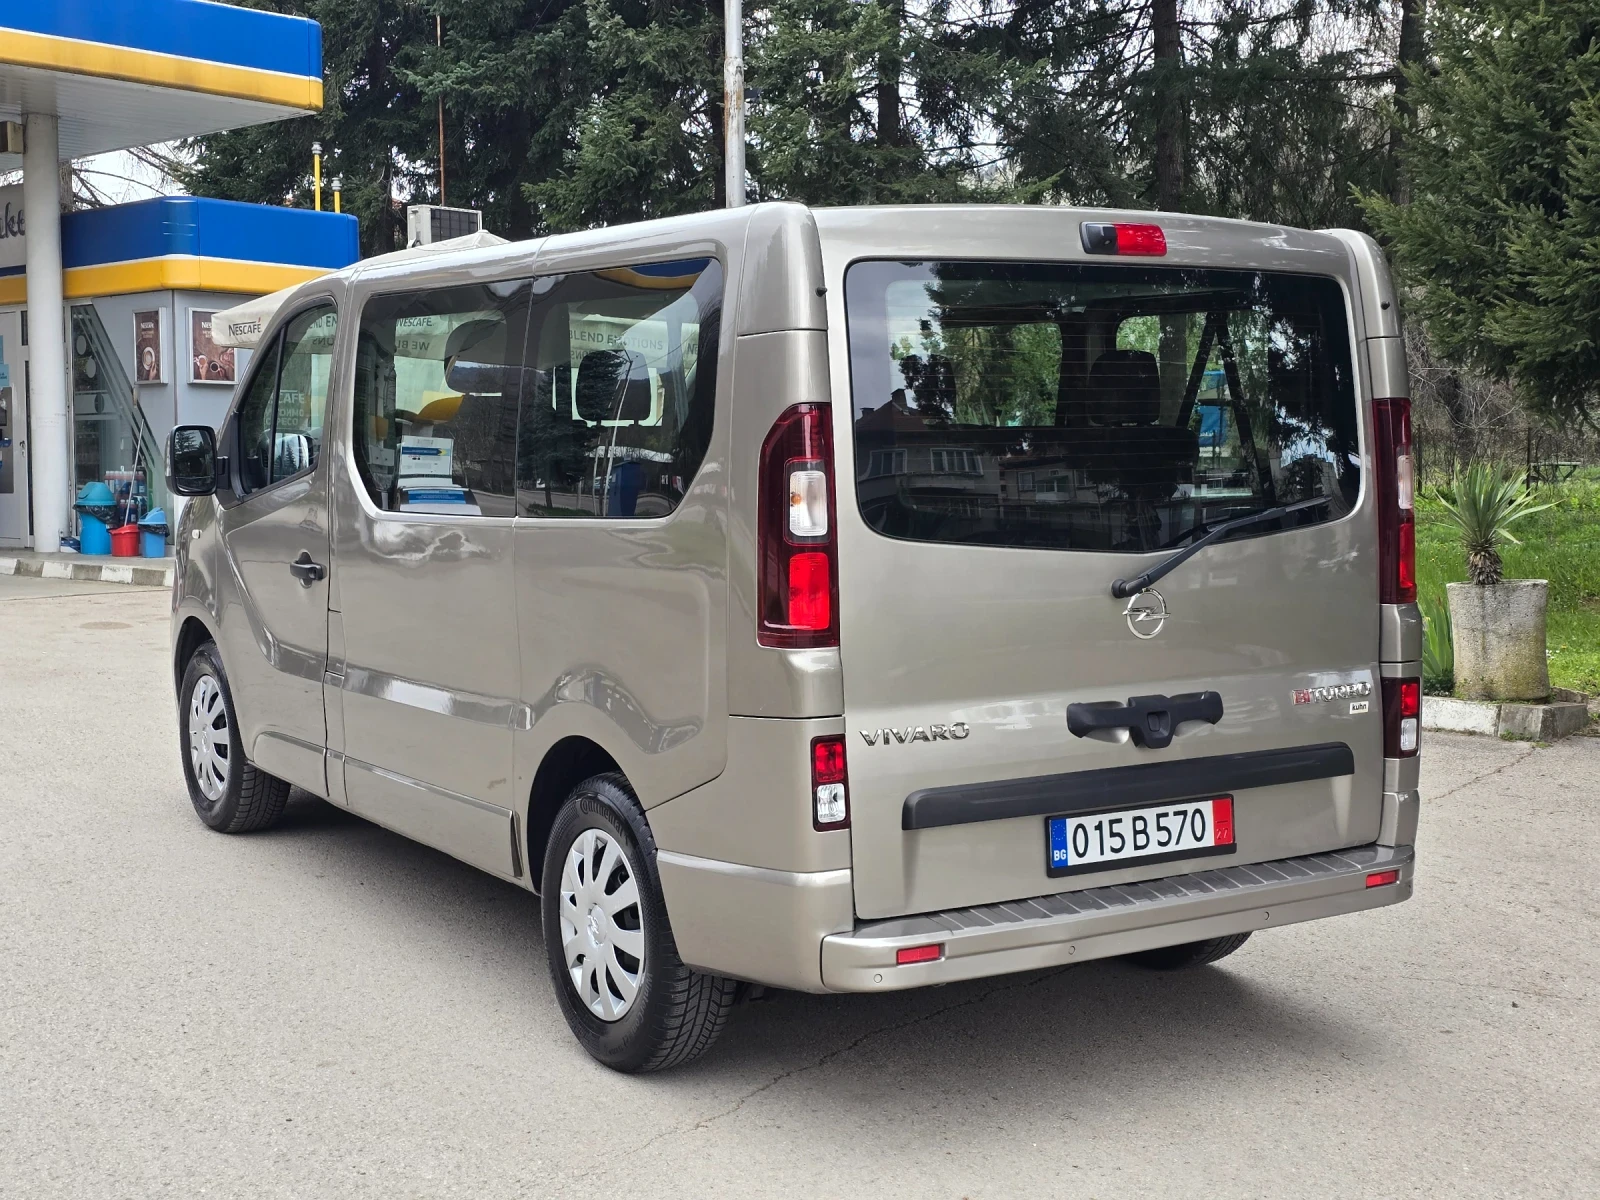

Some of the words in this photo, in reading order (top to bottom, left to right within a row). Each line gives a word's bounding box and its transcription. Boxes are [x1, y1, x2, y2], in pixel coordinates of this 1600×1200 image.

[228, 317, 262, 337] NESCAFÉ
[858, 722, 970, 747] VIVARO
[1054, 850, 1067, 862] BG
